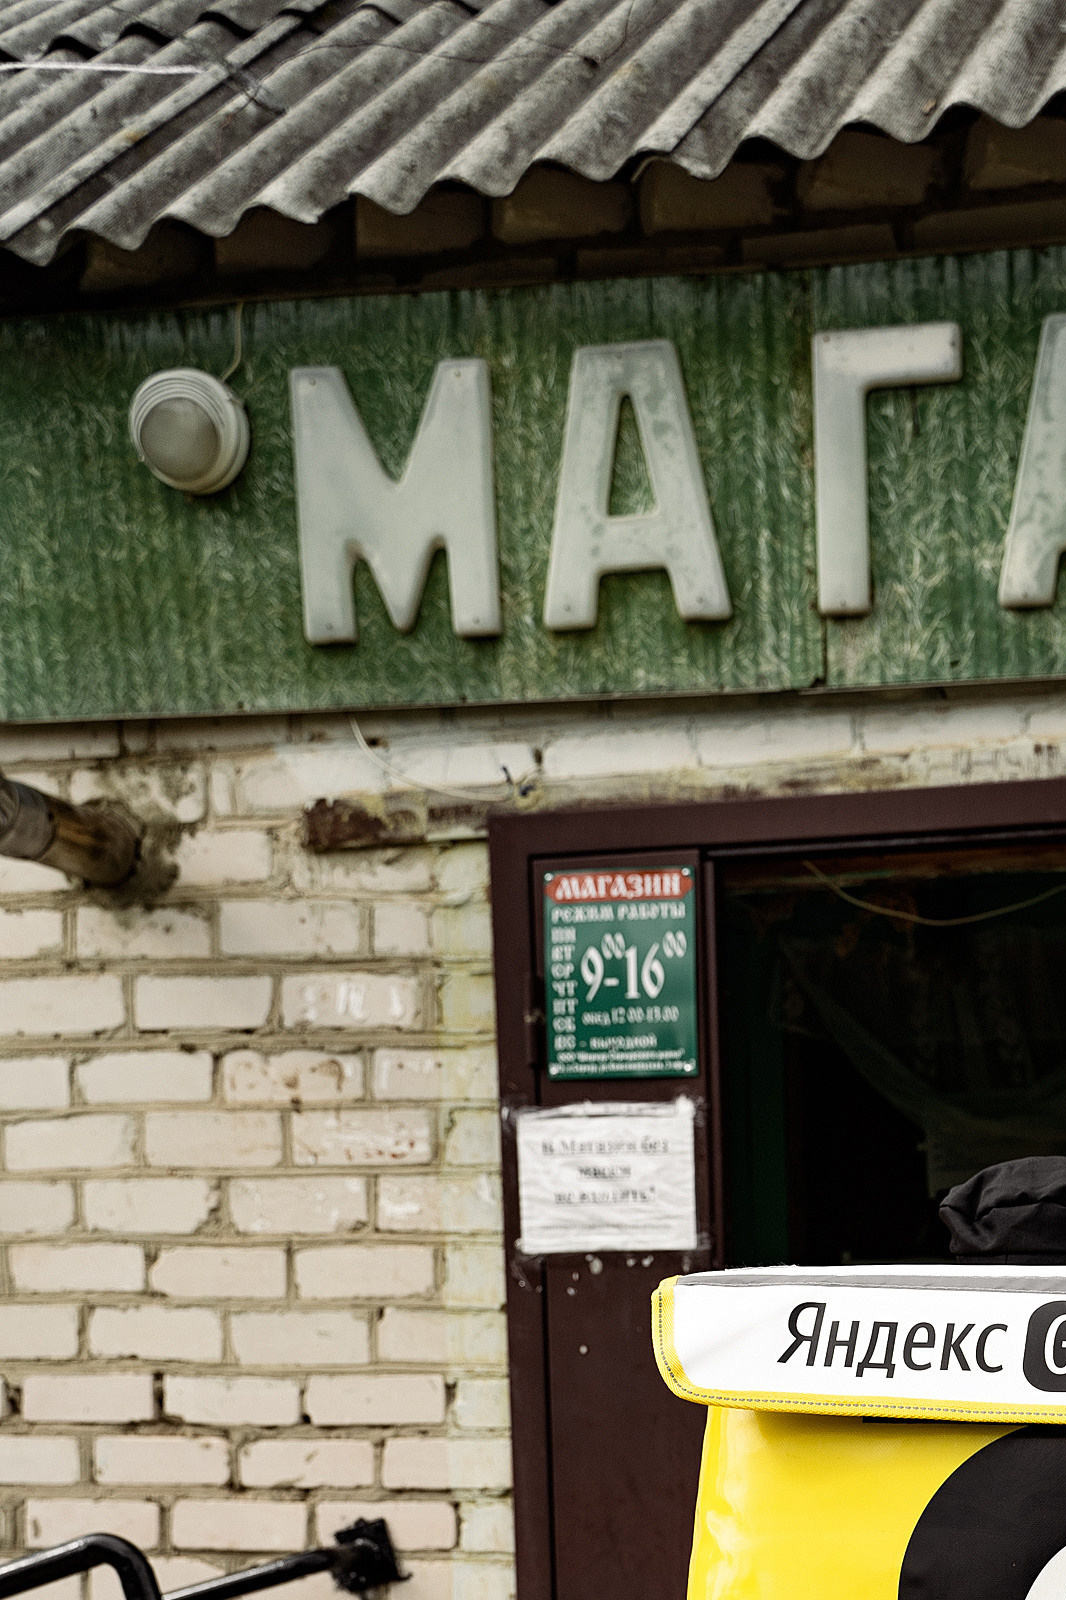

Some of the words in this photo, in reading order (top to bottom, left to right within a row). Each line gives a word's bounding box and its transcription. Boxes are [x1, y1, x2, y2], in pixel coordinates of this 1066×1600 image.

[555, 873, 681, 900] МАГАЗИН
[551, 905, 614, 924] РЕЖИМ
[617, 902, 686, 921] РАБОТЫ
[551, 927, 576, 944] ПН
[551, 944, 575, 962] ВТ
[551, 962, 574, 979] СР
[552, 980, 578, 997] ЧТ
[553, 998, 578, 1015] ПТ
[553, 1016, 576, 1033] СБ
[554, 1034, 576, 1051] ВС
[777, 1302, 1008, 1378] Яндекс
